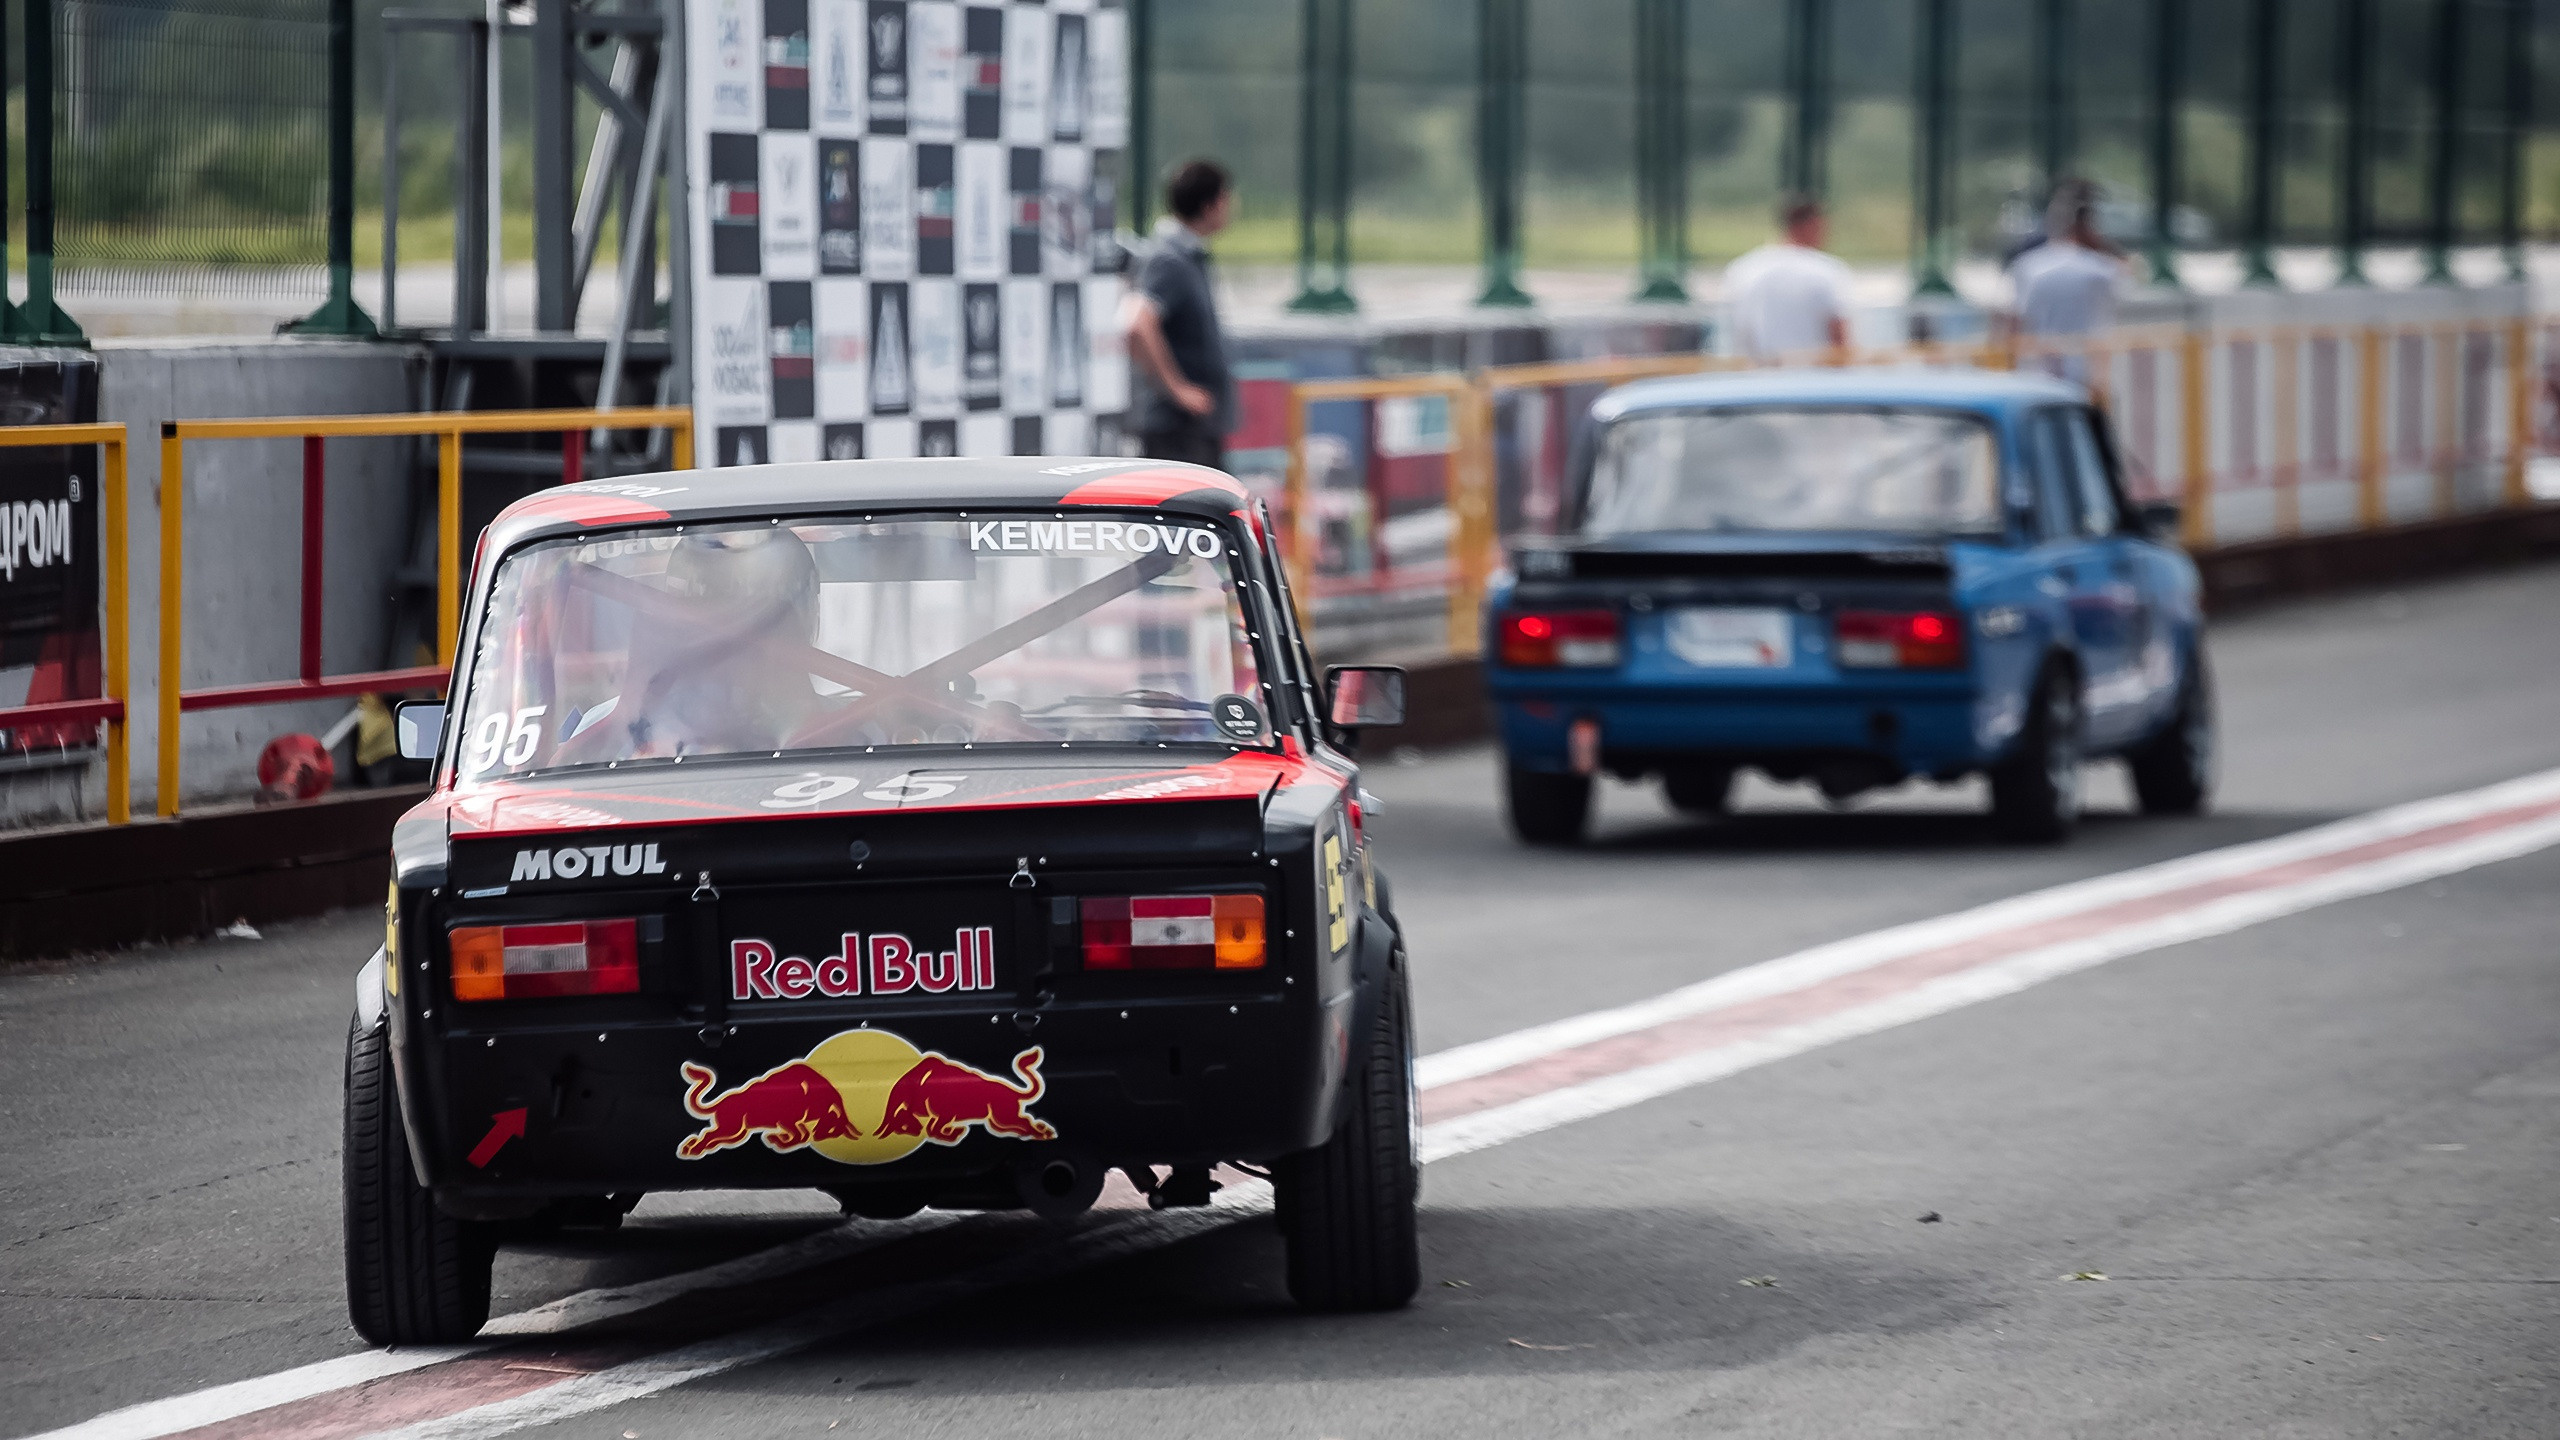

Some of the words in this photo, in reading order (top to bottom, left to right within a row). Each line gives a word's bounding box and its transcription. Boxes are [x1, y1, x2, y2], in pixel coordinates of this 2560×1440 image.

[969, 520, 1221, 559] KEMEROVO
[472, 705, 547, 774] 95
[760, 774, 968, 808] 95
[510, 843, 667, 882] MOTUL
[731, 932, 861, 1000] Red
[869, 926, 996, 995] Bull
